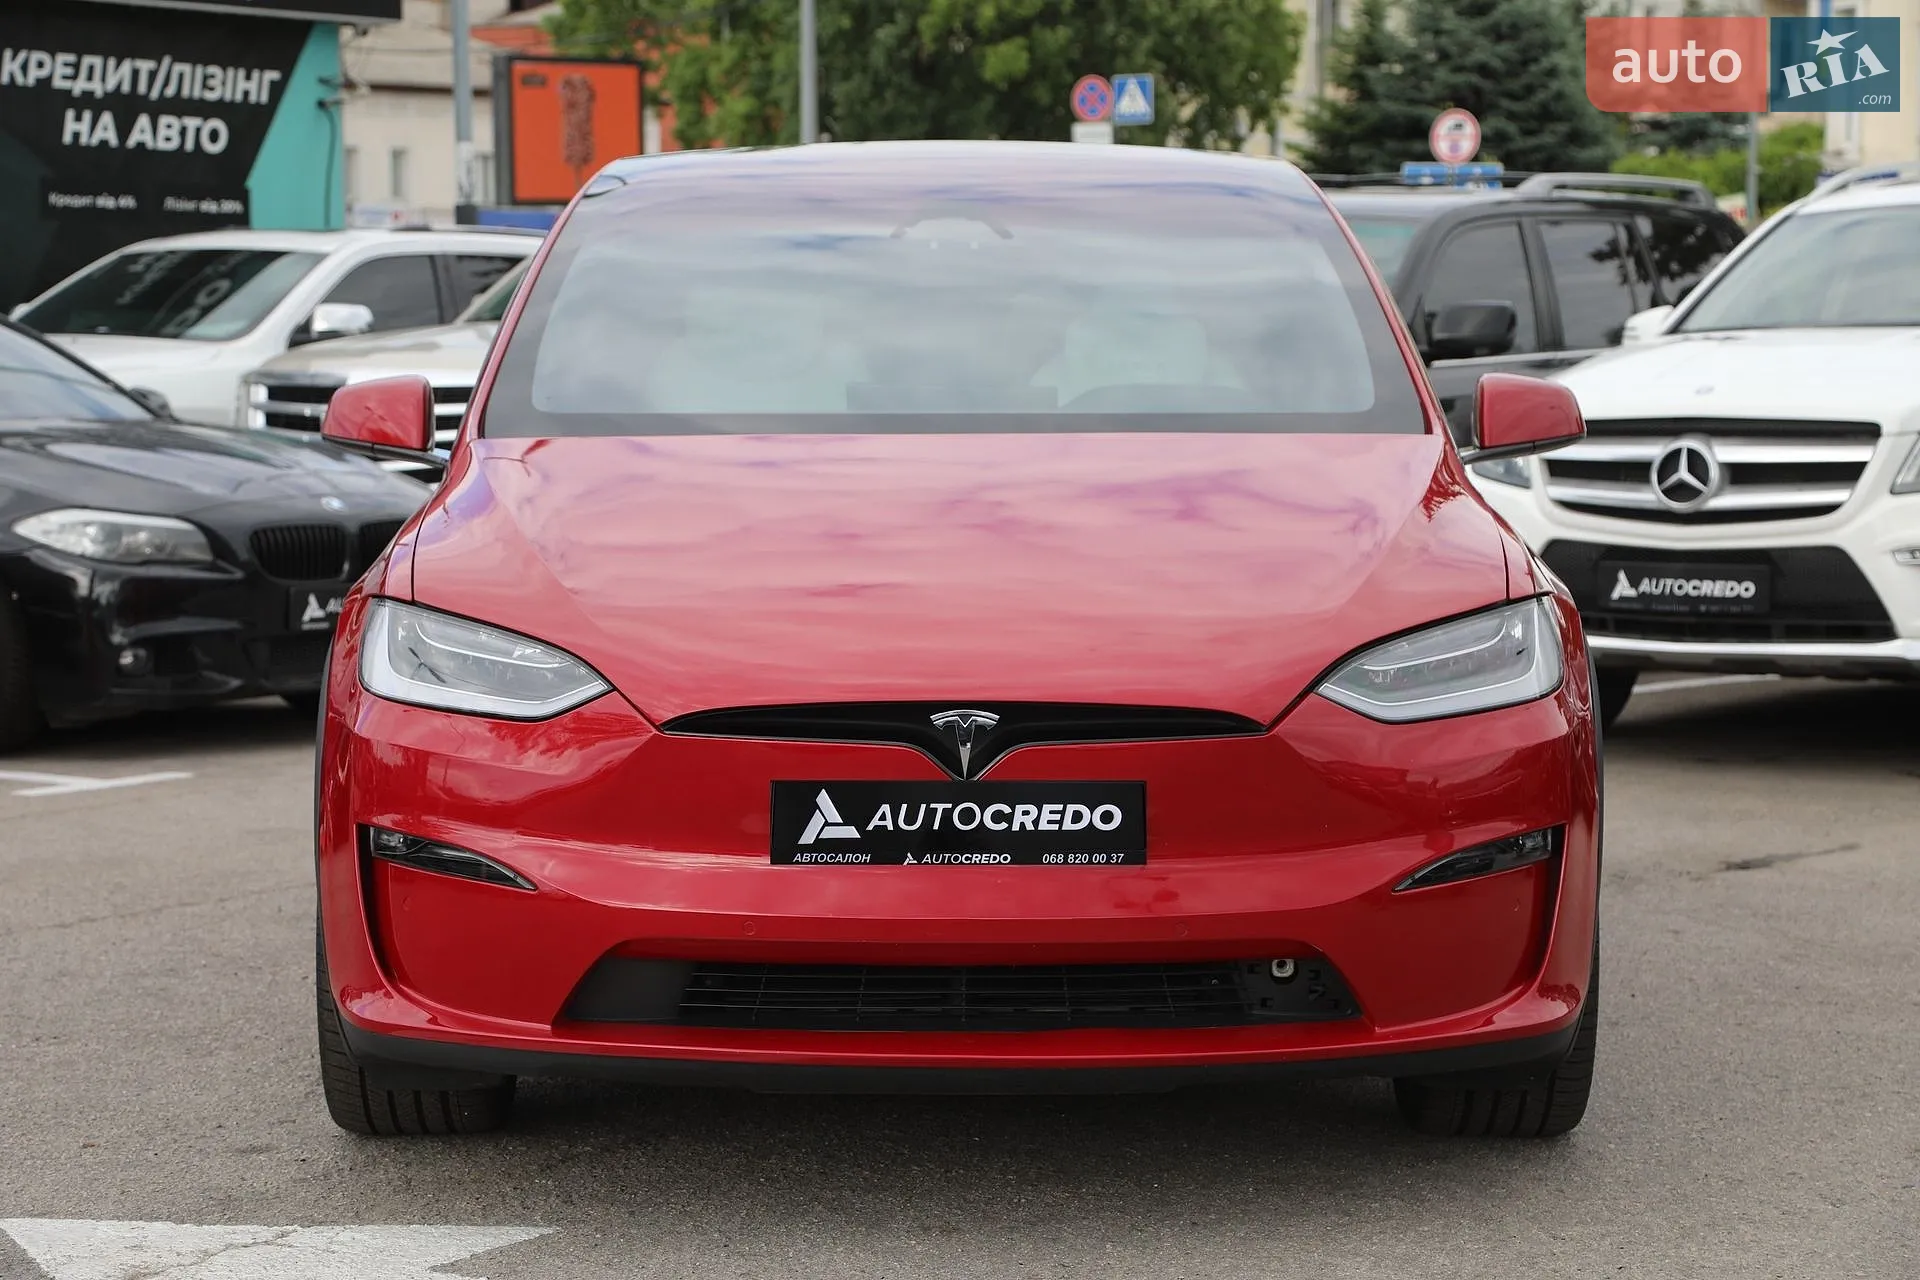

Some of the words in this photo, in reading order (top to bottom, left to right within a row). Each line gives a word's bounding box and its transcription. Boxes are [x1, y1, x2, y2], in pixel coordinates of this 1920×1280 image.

[0, 47, 282, 105] КРЕДИТ/ЛІЗІНГ
[61, 108, 119, 148] НА
[125, 112, 230, 154] АВТО
[1637, 576, 1757, 599] AUTOCREDO
[865, 802, 1123, 832] AUTOCREDO
[792, 853, 871, 863] АВТОСАЛОН
[921, 853, 1012, 864] AUTOCREDO
[1042, 853, 1064, 864] 068
[1067, 853, 1089, 864] 820
[1092, 853, 1107, 864] 00
[1110, 853, 1125, 864] 37
